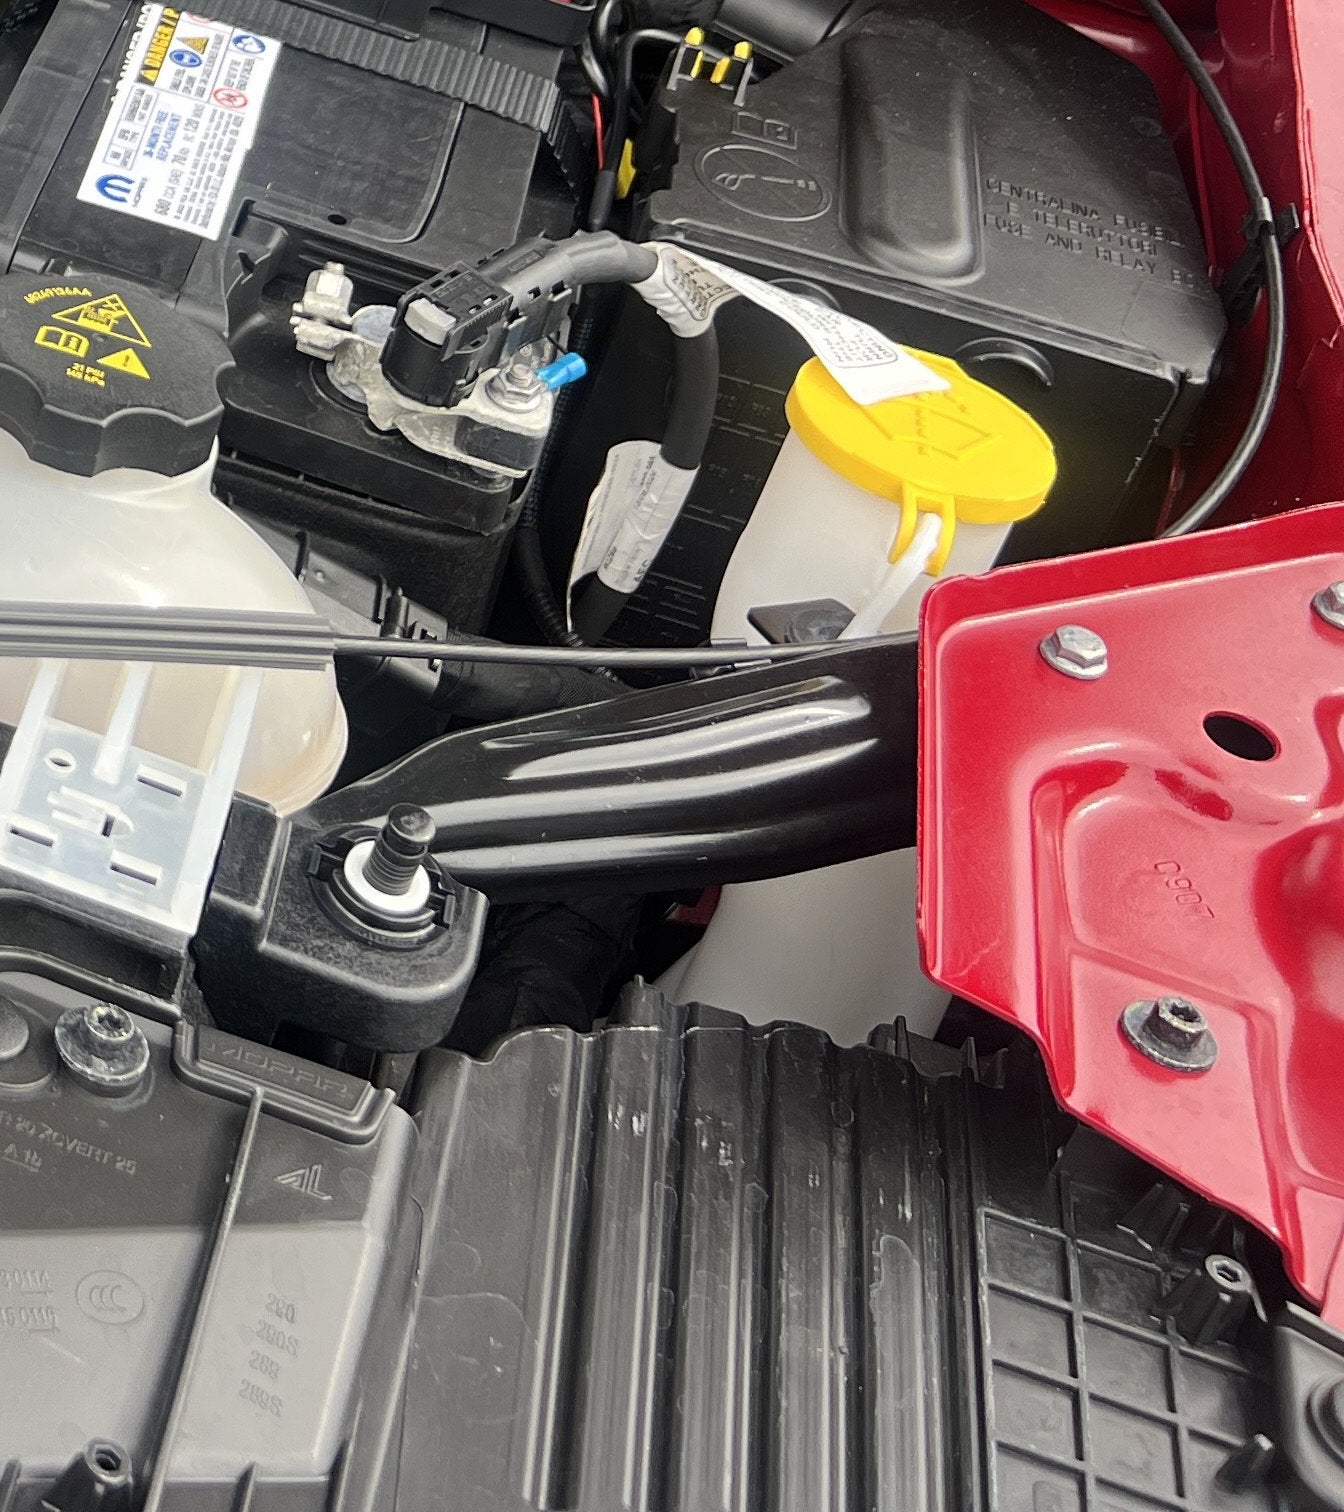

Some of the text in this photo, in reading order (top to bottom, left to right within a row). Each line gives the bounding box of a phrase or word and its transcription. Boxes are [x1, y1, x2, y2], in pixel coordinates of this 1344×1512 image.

[144, 24, 174, 68] DANGER
[156, 114, 182, 161] REPLACEMENT
[984, 212, 1032, 239] FUSE
[1045, 232, 1082, 255] AND
[1096, 245, 1156, 275] RELAY
